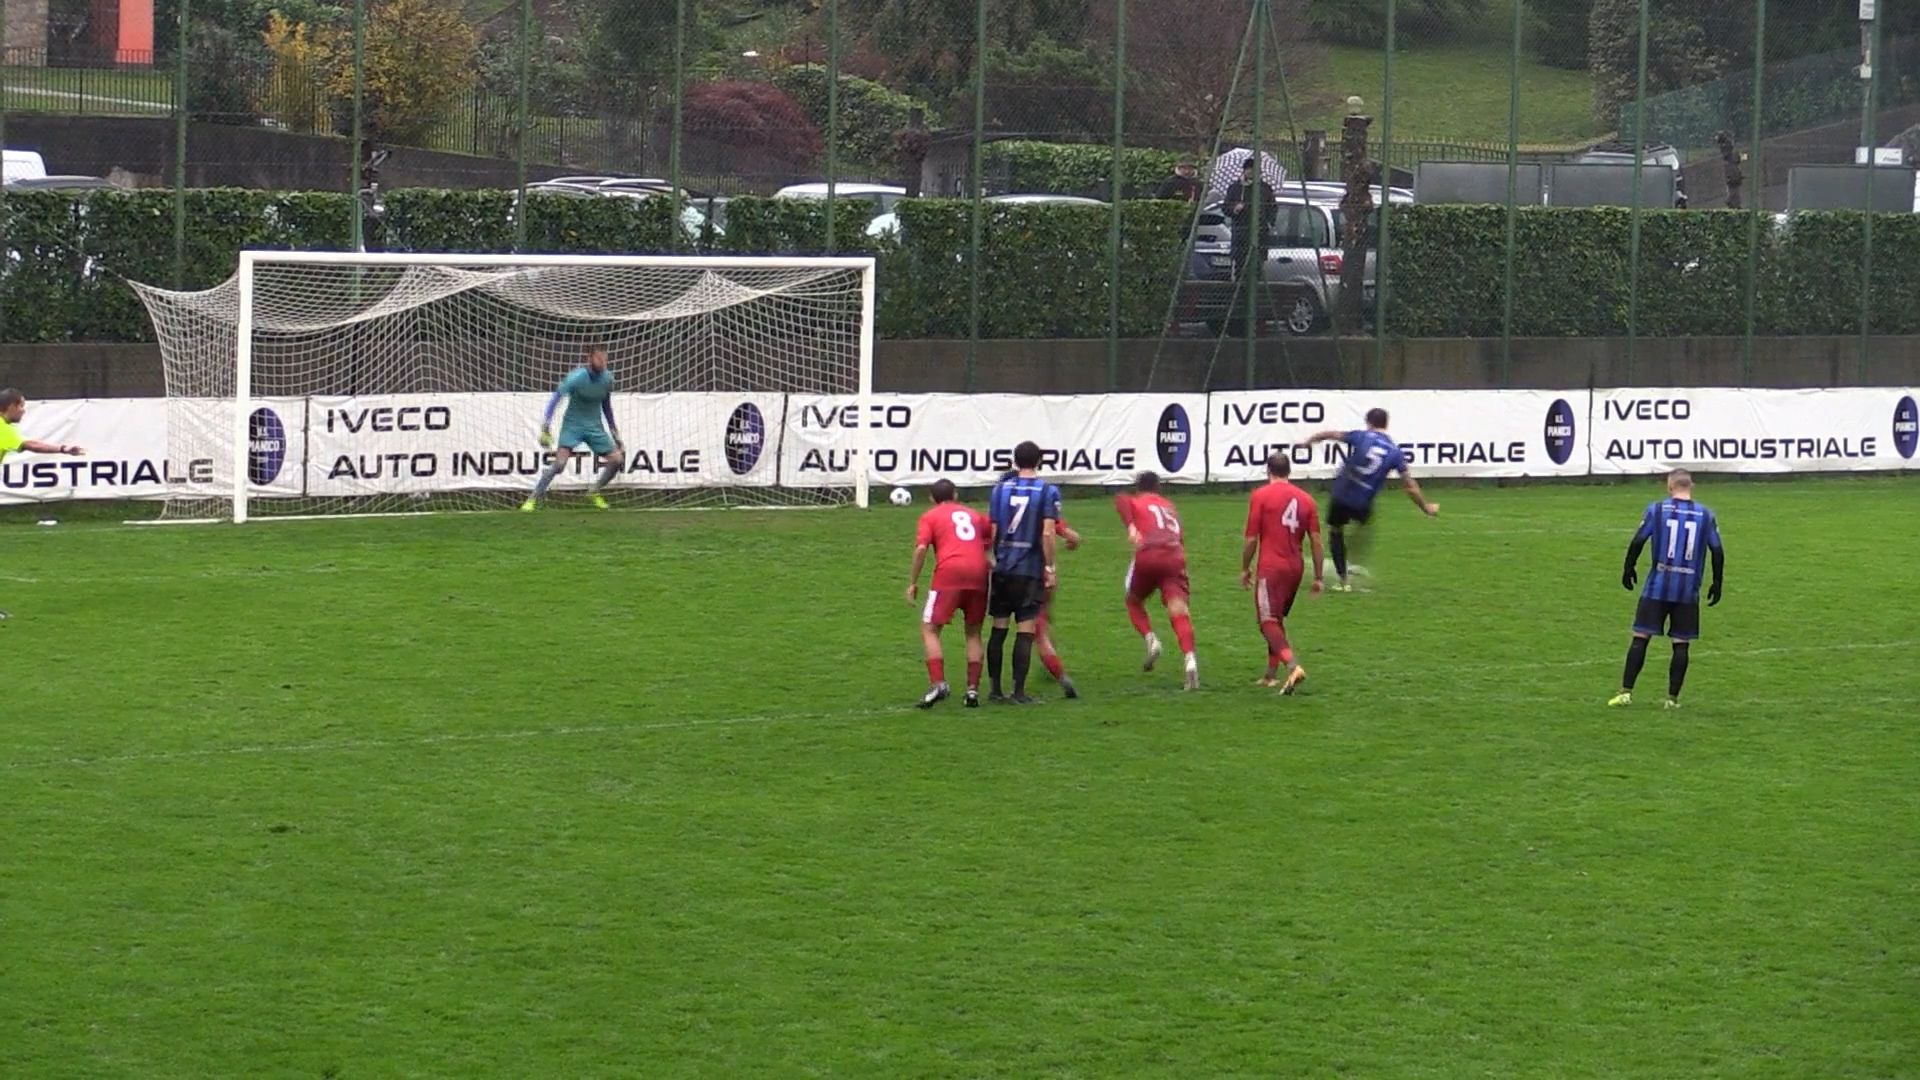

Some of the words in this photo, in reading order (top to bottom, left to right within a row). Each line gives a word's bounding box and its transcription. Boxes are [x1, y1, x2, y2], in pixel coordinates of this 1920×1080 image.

[327, 406, 450, 433] IVECO
[1223, 402, 1325, 425] IVECO
[1604, 399, 1690, 420] IVECO
[799, 448, 898, 472] AUO
[910, 447, 1135, 473] INDUSRIALE
[1224, 443, 1312, 467] AUTO
[1324, 441, 1525, 466] INSTRIALE
[1355, 446, 1388, 475] 5
[1605, 438, 1683, 460] AUTO
[1693, 436, 1877, 460] INDUSTRIALE
[328, 453, 437, 480] AUTO
[951, 510, 976, 541] 8
[1007, 495, 1030, 534] 7
[1147, 504, 1180, 534] 15
[1281, 497, 1300, 534] 4
[1666, 519, 1697, 561] 11
